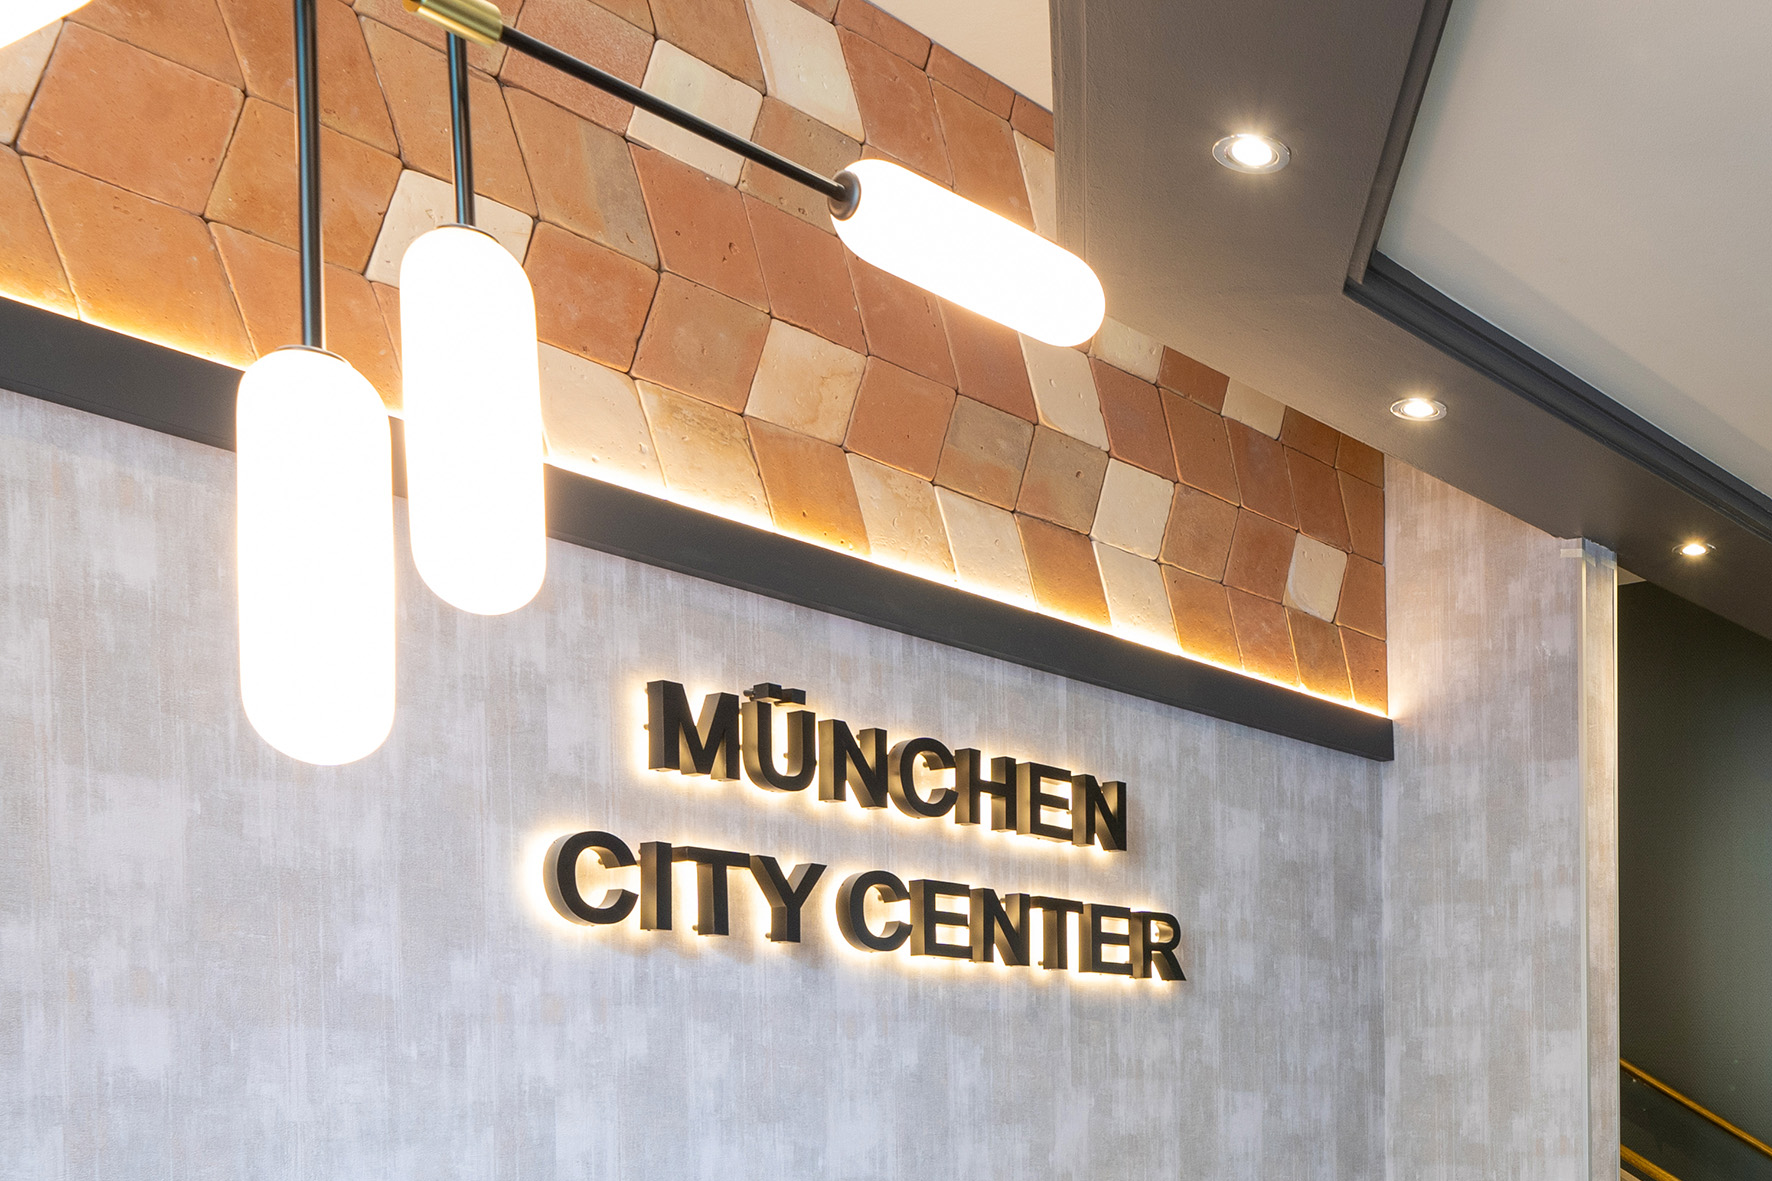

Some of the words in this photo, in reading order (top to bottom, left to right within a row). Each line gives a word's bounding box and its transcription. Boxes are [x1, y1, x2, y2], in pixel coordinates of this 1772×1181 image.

[646, 680, 1127, 852] MÜNCHEN
[543, 831, 827, 943] CITY
[837, 870, 1186, 981] CENTER
